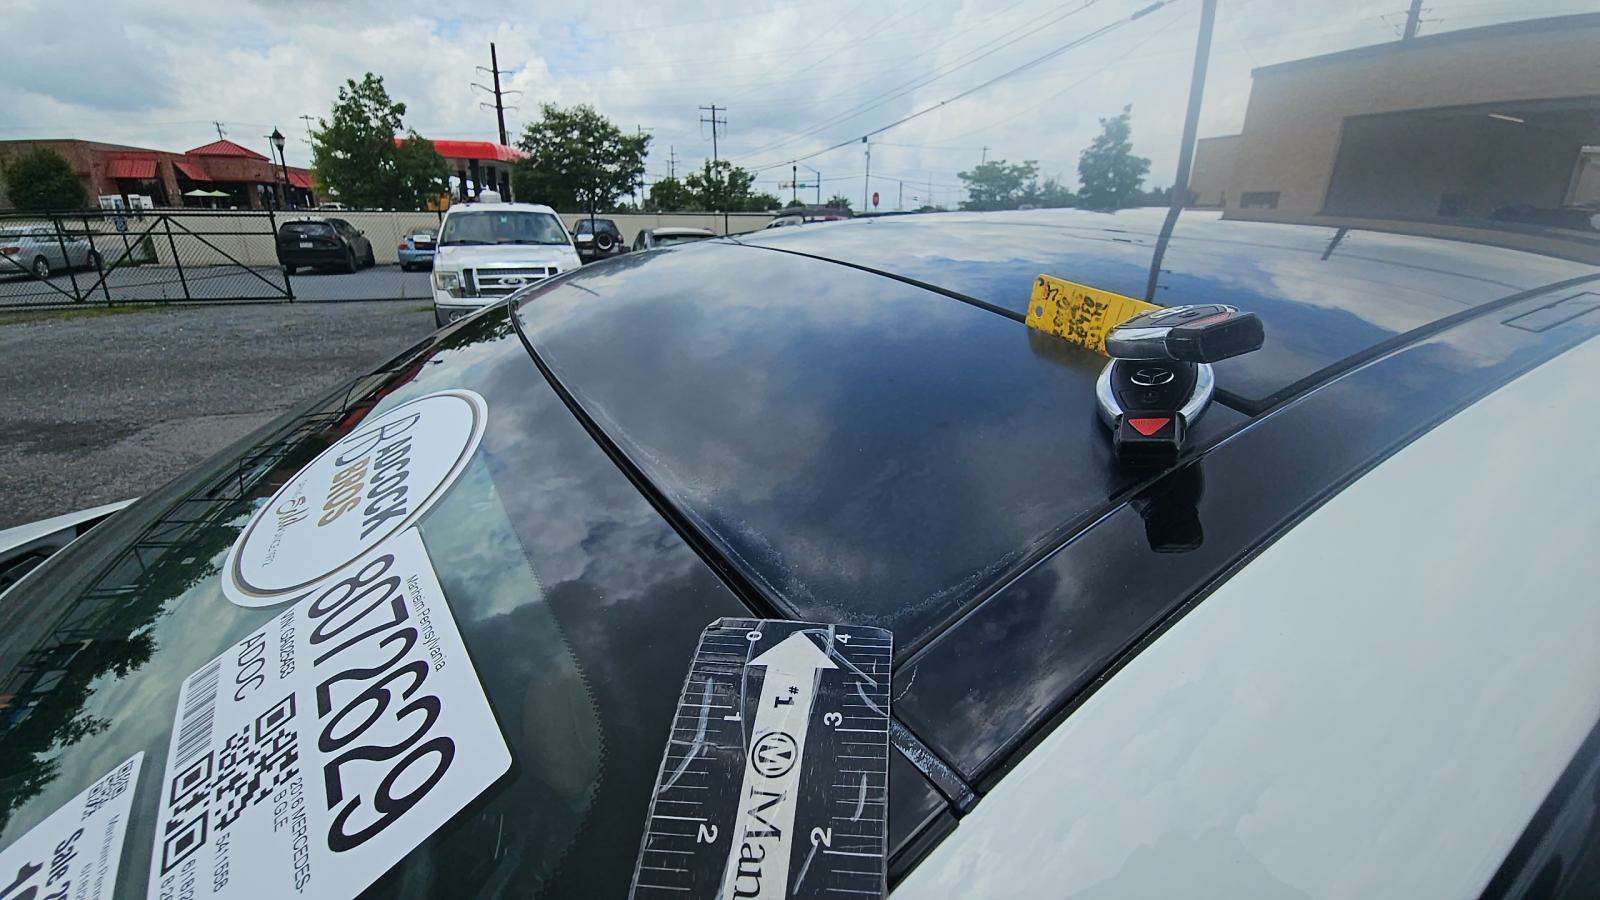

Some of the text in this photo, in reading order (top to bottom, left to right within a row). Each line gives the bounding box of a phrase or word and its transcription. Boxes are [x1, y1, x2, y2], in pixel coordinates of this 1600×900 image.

[317, 456, 371, 527] BROS
[279, 608, 295, 680] VIN: GA025453
[406, 574, 447, 672] Manheim Pennsylvania
[234, 632, 266, 702] ADOC
[308, 554, 455, 852] 8072629
[824, 712, 843, 727] 3
[273, 789, 289, 833] B GLE
[289, 776, 312, 894] 2016 MERCEDES-
[697, 824, 718, 844] 2
[810, 827, 832, 847] 2
[46, 828, 84, 887] Sale
[213, 831, 231, 894] 5411558
